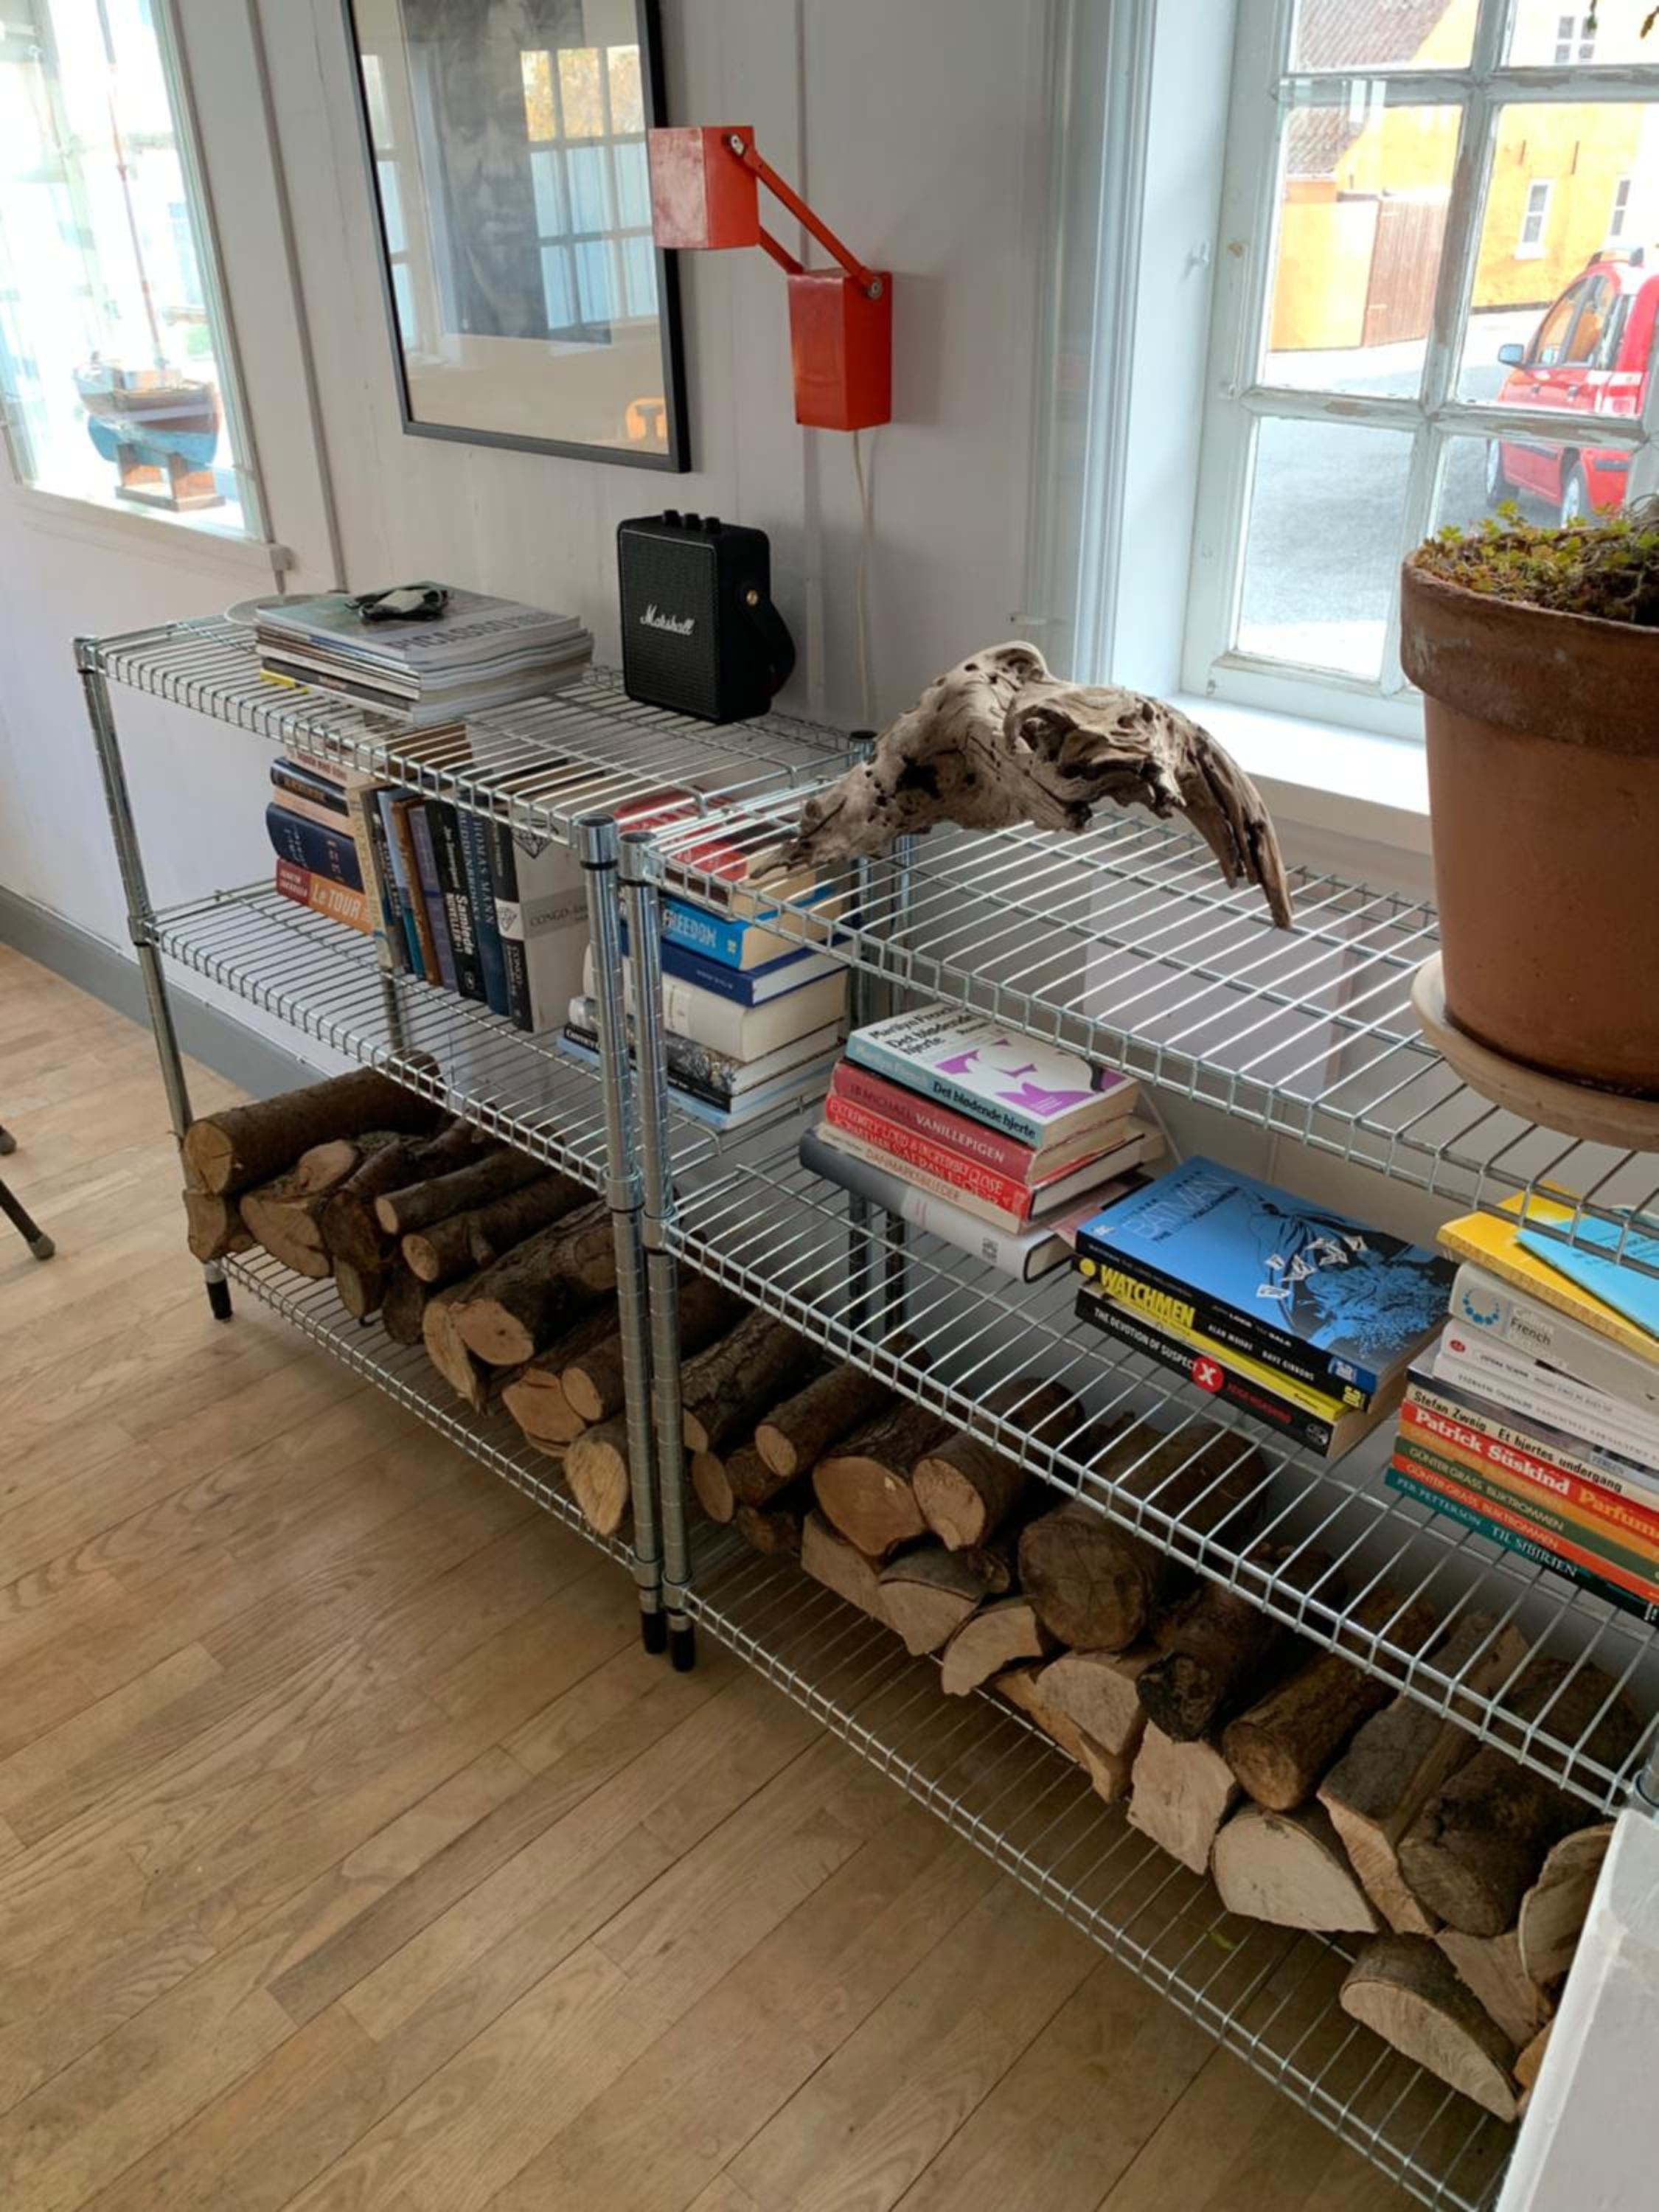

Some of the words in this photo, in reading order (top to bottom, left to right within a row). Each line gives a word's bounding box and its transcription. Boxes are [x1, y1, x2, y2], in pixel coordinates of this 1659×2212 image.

[639, 604, 695, 636] Marshall
[313, 883, 327, 905] Le
[327, 888, 362, 920] TOUR
[456, 893, 475, 956] Samlede
[663, 908, 717, 949] FREEDOM
[932, 1081, 952, 1099] Det
[1003, 1113, 1037, 1139] hjerte
[915, 1112, 1007, 1164] VANILLEPIGEN
[967, 1166, 1004, 1196] CLOSE
[1099, 1263, 1197, 1328] WATCHMEN
[1093, 1306, 1110, 1324] THE
[1110, 1318, 1150, 1346] DEVOTION
[1149, 1338, 1162, 1351] OF
[1198, 1362, 1217, 1387] X
[1511, 1316, 1553, 1345] French
[1413, 1391, 1449, 1415] Stefan
[1452, 1408, 1487, 1433] Zweig
[1498, 1427, 1512, 1442] Et
[1514, 1434, 1554, 1462] hjertes
[1558, 1457, 1623, 1494] undergang
[1414, 1408, 1484, 1453] Patrick
[1487, 1444, 1571, 1495] Süskind
[1449, 1465, 1484, 1489] GRASS
[1491, 1524, 1512, 1543] TIL
[1515, 1537, 1578, 1578] SIBIRIEN
